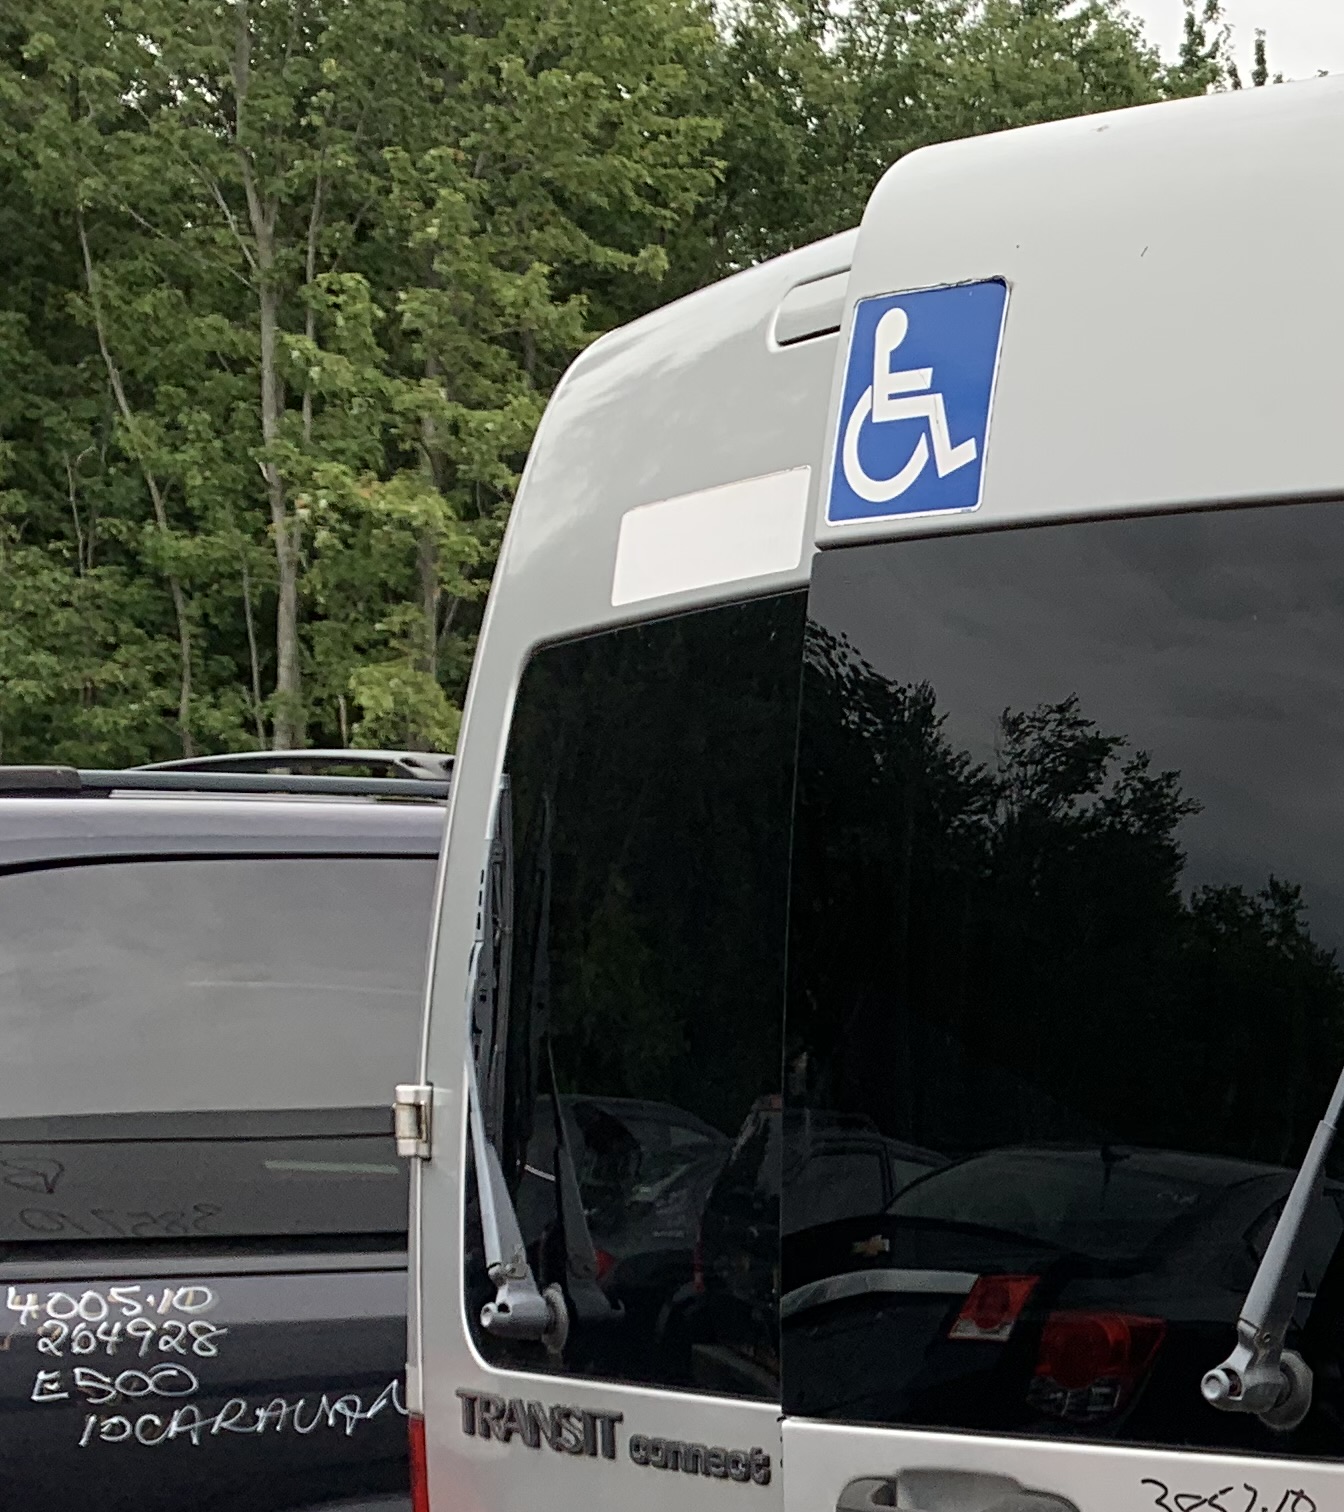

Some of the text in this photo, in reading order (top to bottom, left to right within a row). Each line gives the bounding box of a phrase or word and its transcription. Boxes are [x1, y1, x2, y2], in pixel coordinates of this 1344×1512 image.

[37, 1317, 228, 1358] 264928
[455, 1388, 771, 1485] TRANSIT connect
